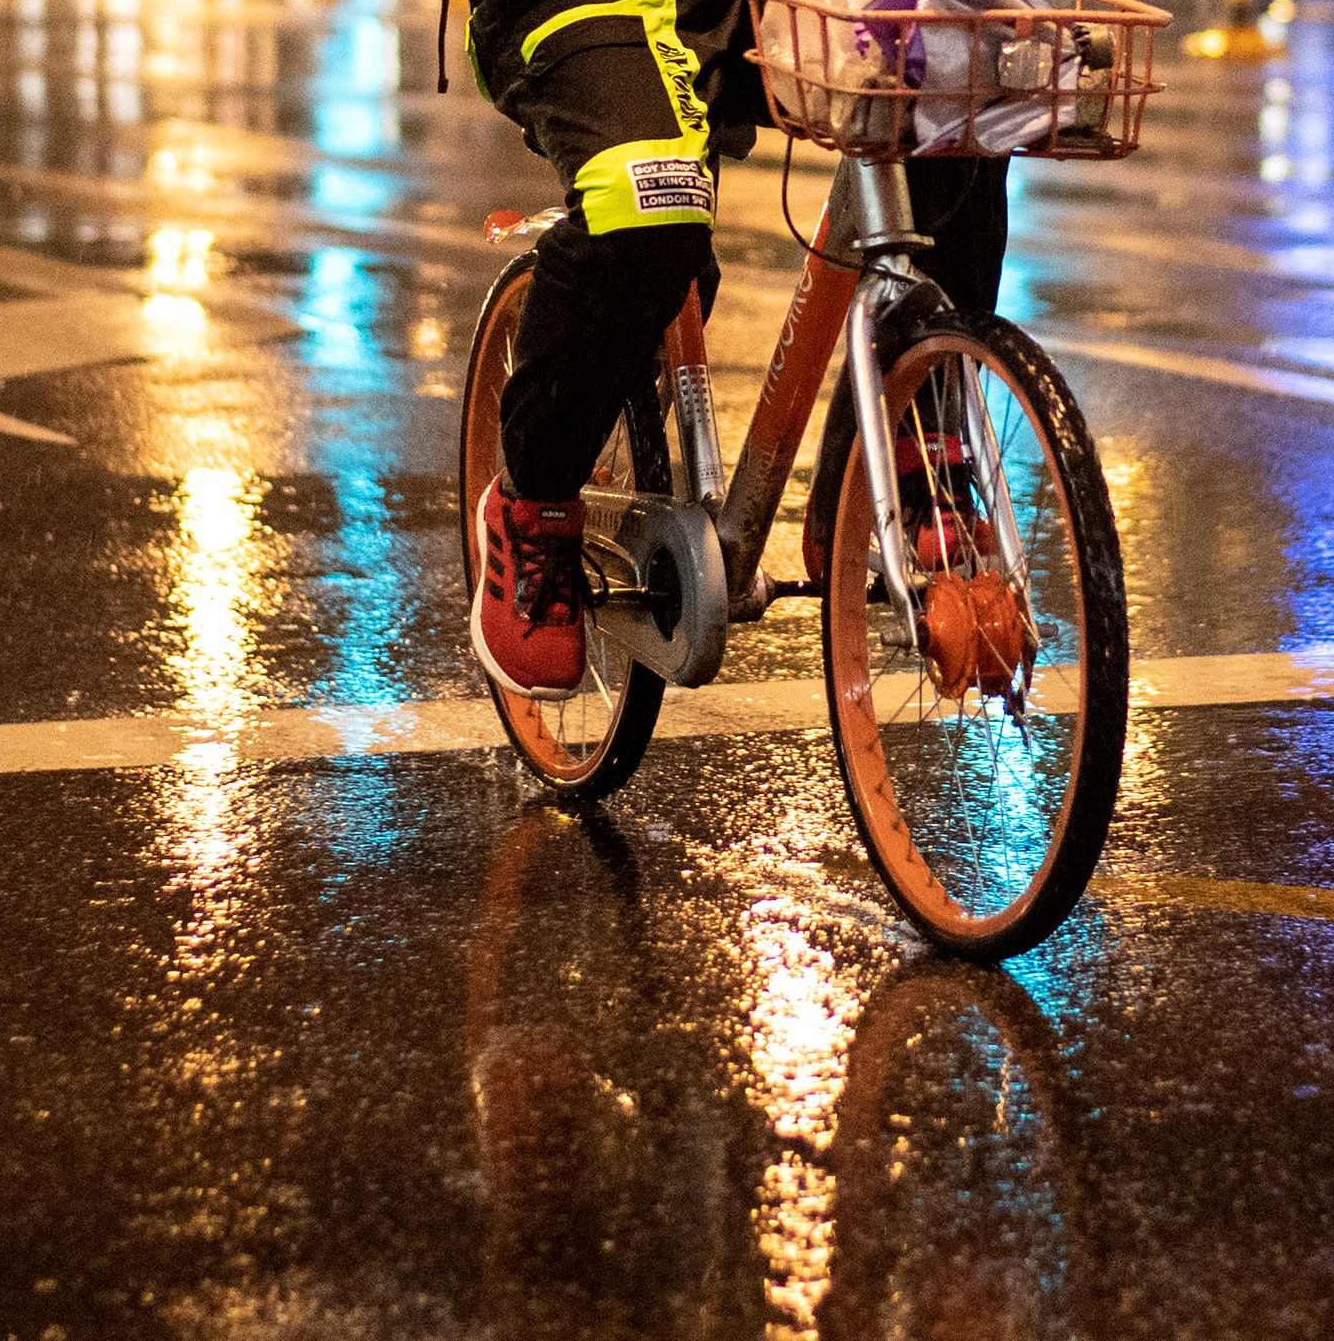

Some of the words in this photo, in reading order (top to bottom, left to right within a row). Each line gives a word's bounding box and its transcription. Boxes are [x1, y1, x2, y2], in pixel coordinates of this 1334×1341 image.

[634, 165, 658, 175] BOY
[661, 162, 698, 172] LONDO
[642, 195, 690, 207] LONDON
